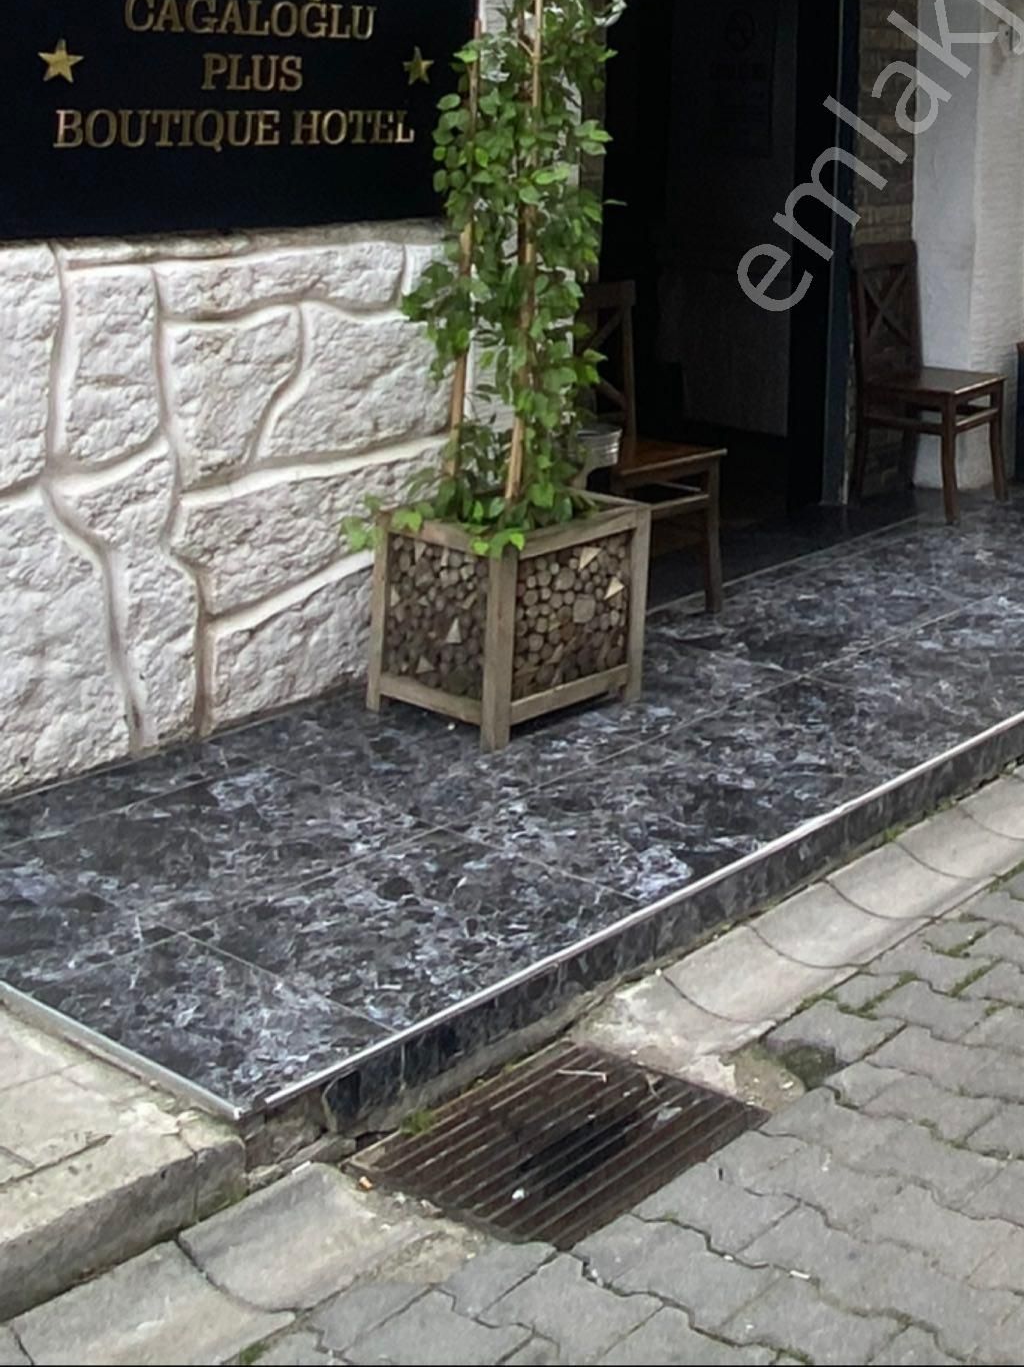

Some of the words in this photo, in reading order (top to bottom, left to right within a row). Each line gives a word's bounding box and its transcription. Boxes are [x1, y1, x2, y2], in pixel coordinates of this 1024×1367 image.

[200, 52, 303, 93] PLUS
[52, 109, 281, 153] BOUTIQUE
[290, 109, 415, 146] HOTEL
